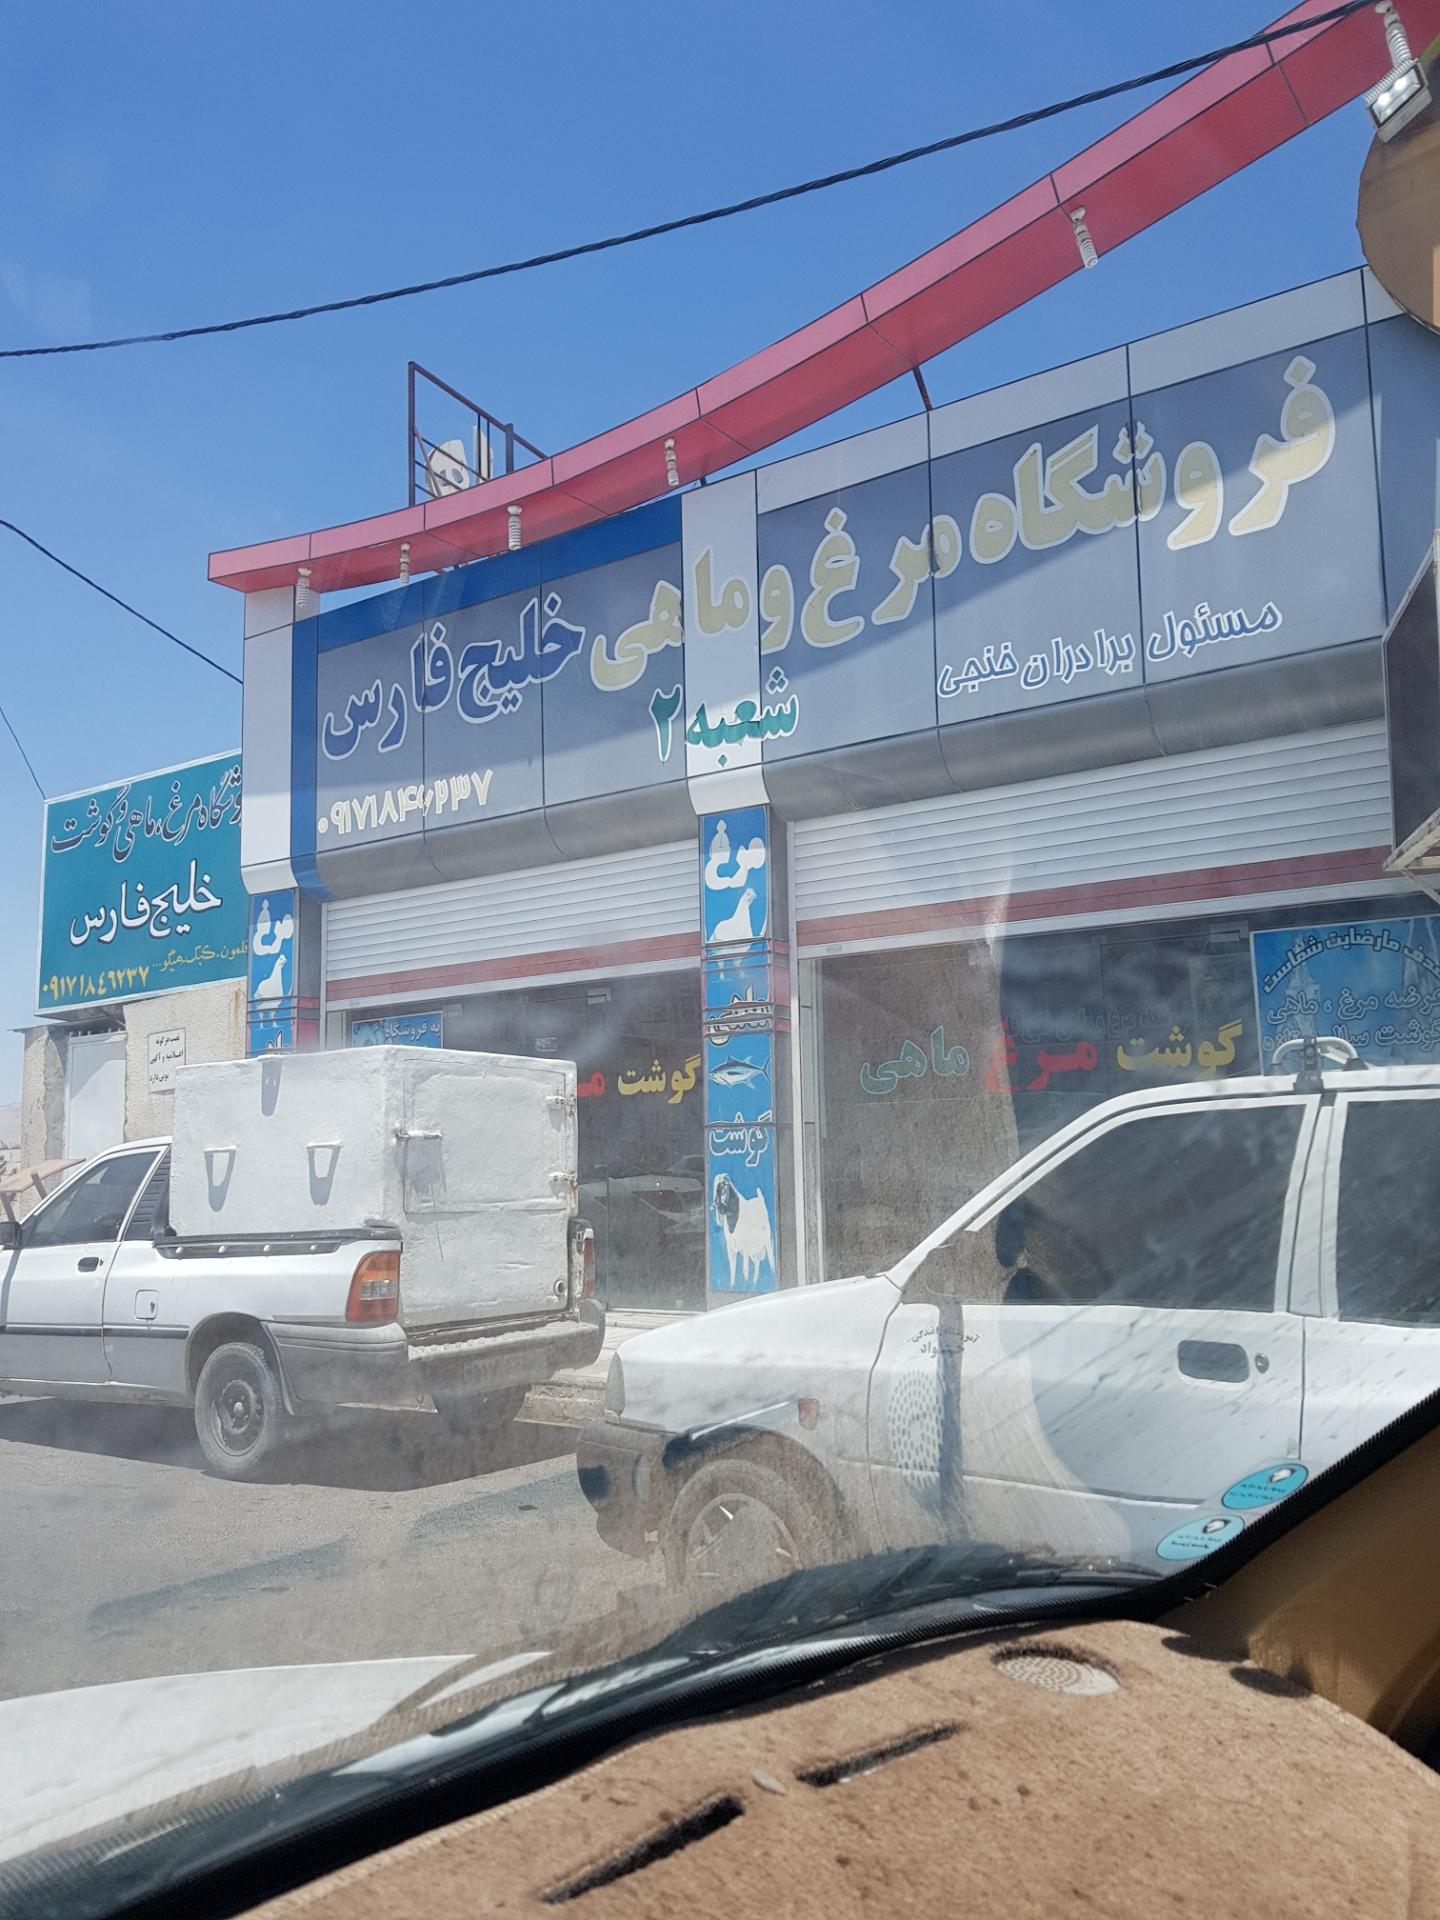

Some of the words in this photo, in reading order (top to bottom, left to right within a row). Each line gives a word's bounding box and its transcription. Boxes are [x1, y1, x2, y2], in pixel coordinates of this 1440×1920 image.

[969, 355, 1336, 564] فروشگاه
[757, 564, 794, 655] و
[800, 507, 963, 648] مرغ
[590, 546, 752, 691] ماهی
[1147, 601, 1283, 663] مسئول
[321, 621, 455, 760] فارس
[457, 592, 585, 723] خلیج
[938, 641, 1019, 698] خنجی
[1020, 629, 1137, 689] برادران
[684, 666, 800, 768] شعبه
[52, 783, 132, 853] گوشت
[113, 795, 156, 864] ماهی
[705, 819, 766, 890] مرغ
[70, 879, 151, 948] فارس
[149, 858, 223, 938] خلیج
[253, 899, 295, 956] مرغ
[1263, 935, 1323, 994] شماست
[1266, 992, 1319, 1025] ماهی
[617, 1053, 701, 1104] گوشت
[859, 1026, 971, 1095] ماهی
[984, 1015, 1097, 1093] مرغ
[1116, 1018, 1243, 1082] گوشت
[708, 1108, 772, 1168] گوشت
